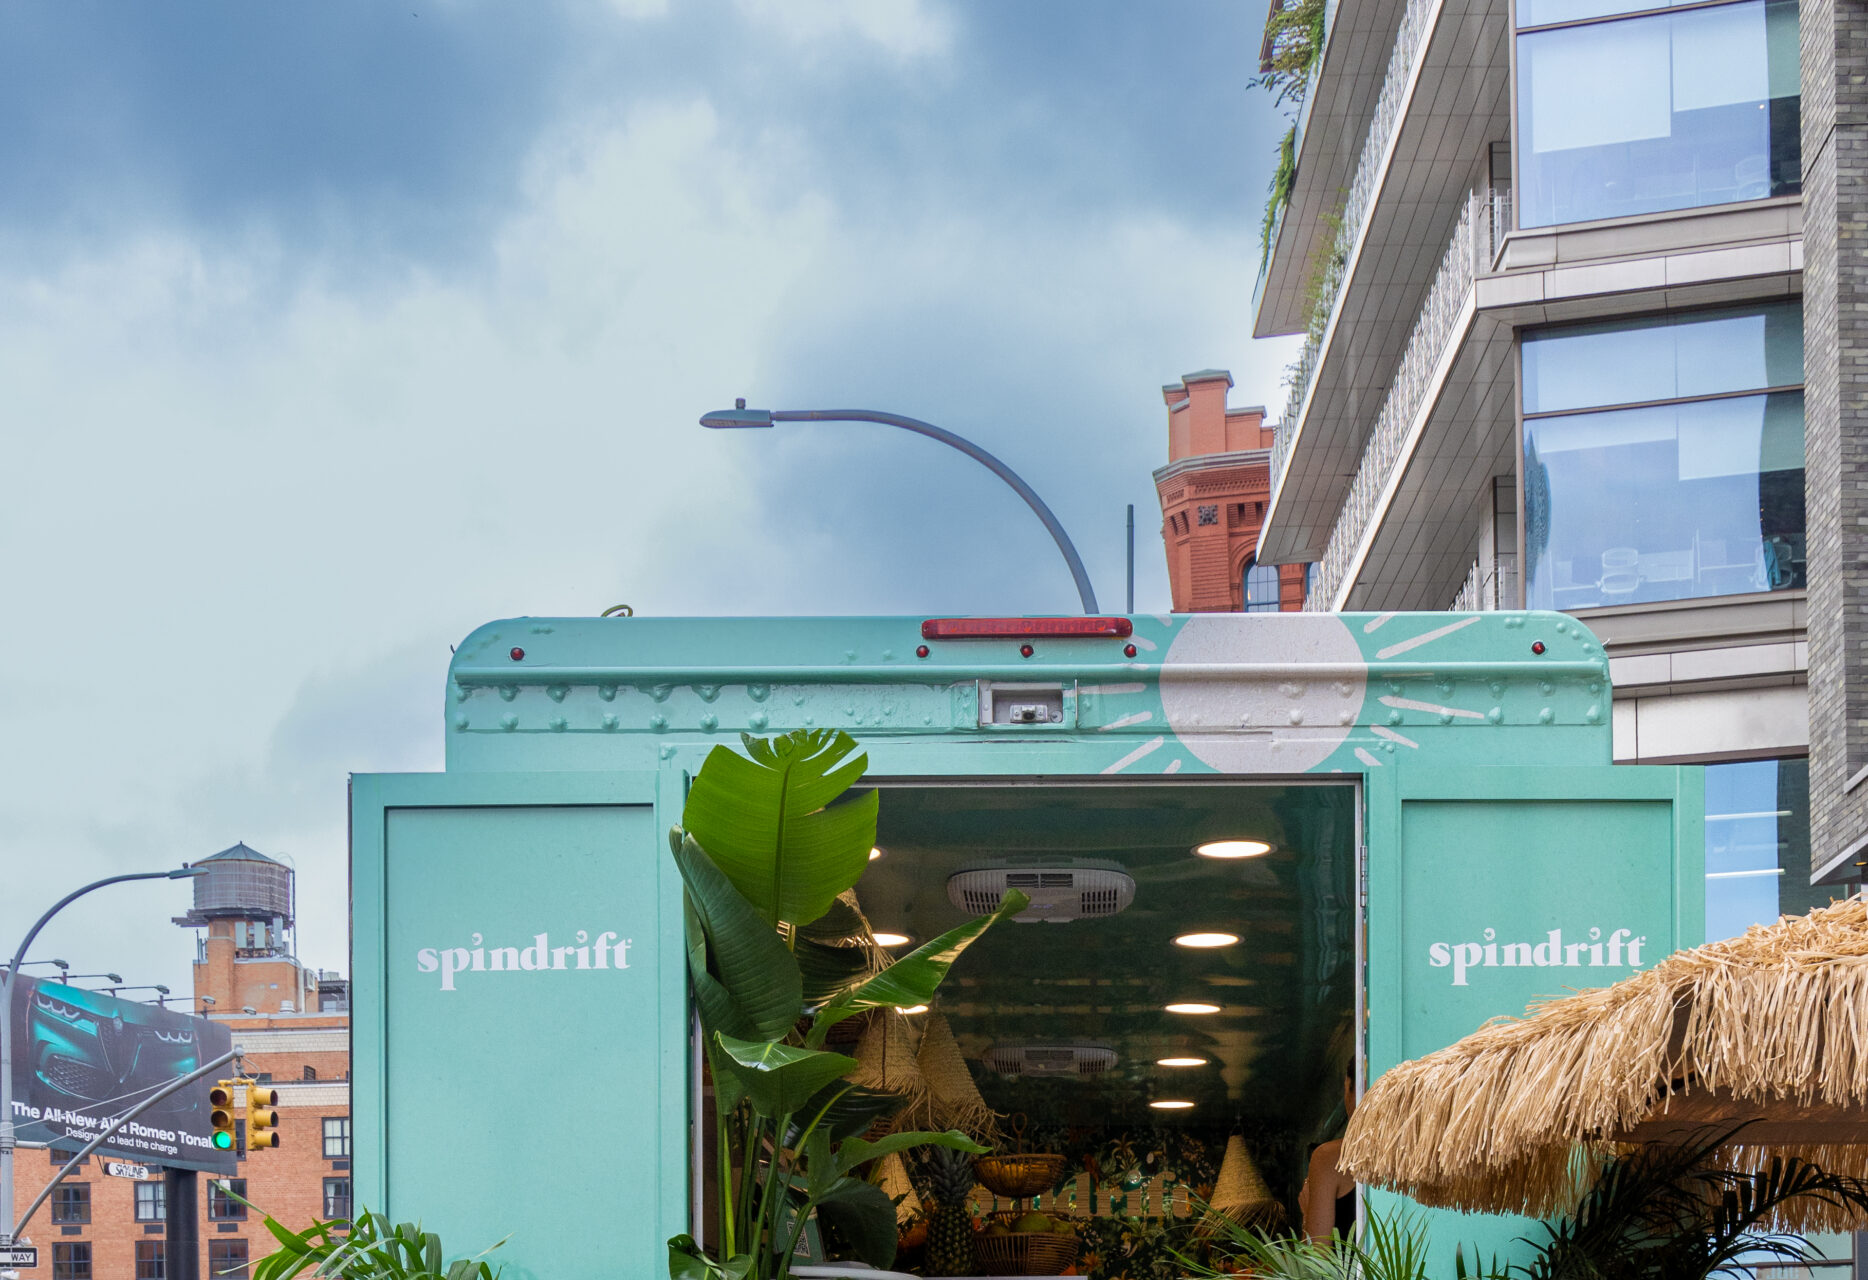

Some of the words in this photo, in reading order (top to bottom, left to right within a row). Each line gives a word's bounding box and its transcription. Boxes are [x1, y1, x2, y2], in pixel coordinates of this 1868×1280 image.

[417, 929, 633, 991] spindrift
[1429, 926, 1647, 986] spindrift
[11, 1101, 40, 1119] The
[43, 1107, 97, 1128] All-New
[129, 1121, 176, 1141] Romeo
[178, 1130, 216, 1150] Tonal
[66, 1127, 105, 1143] Designe
[117, 1136, 135, 1147] lead
[136, 1138, 149, 1149] the
[150, 1141, 178, 1155] charge
[115, 1163, 144, 1178] SKYLINE
[11, 1253, 31, 1262] WAY
